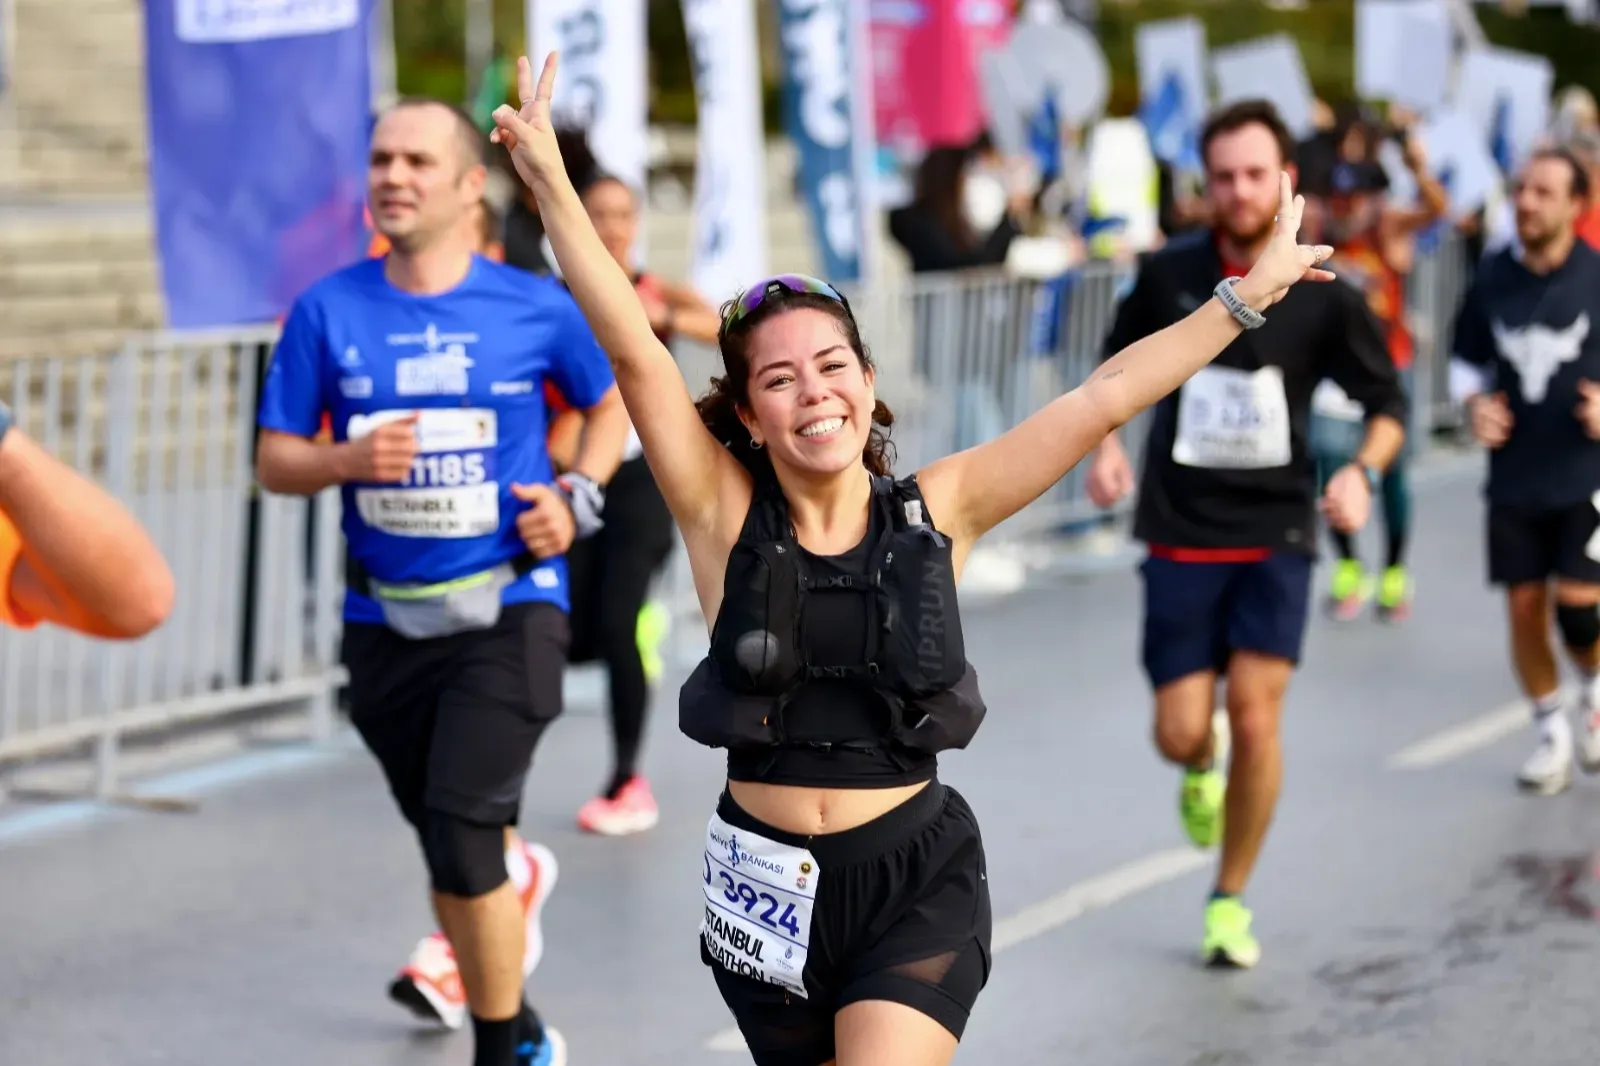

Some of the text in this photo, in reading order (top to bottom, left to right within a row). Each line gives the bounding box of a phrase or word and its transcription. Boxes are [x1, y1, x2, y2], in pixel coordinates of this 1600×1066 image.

[741, 851, 785, 876] BANKASI
[719, 870, 800, 938] 3924
[705, 905, 765, 964] STANBUL
